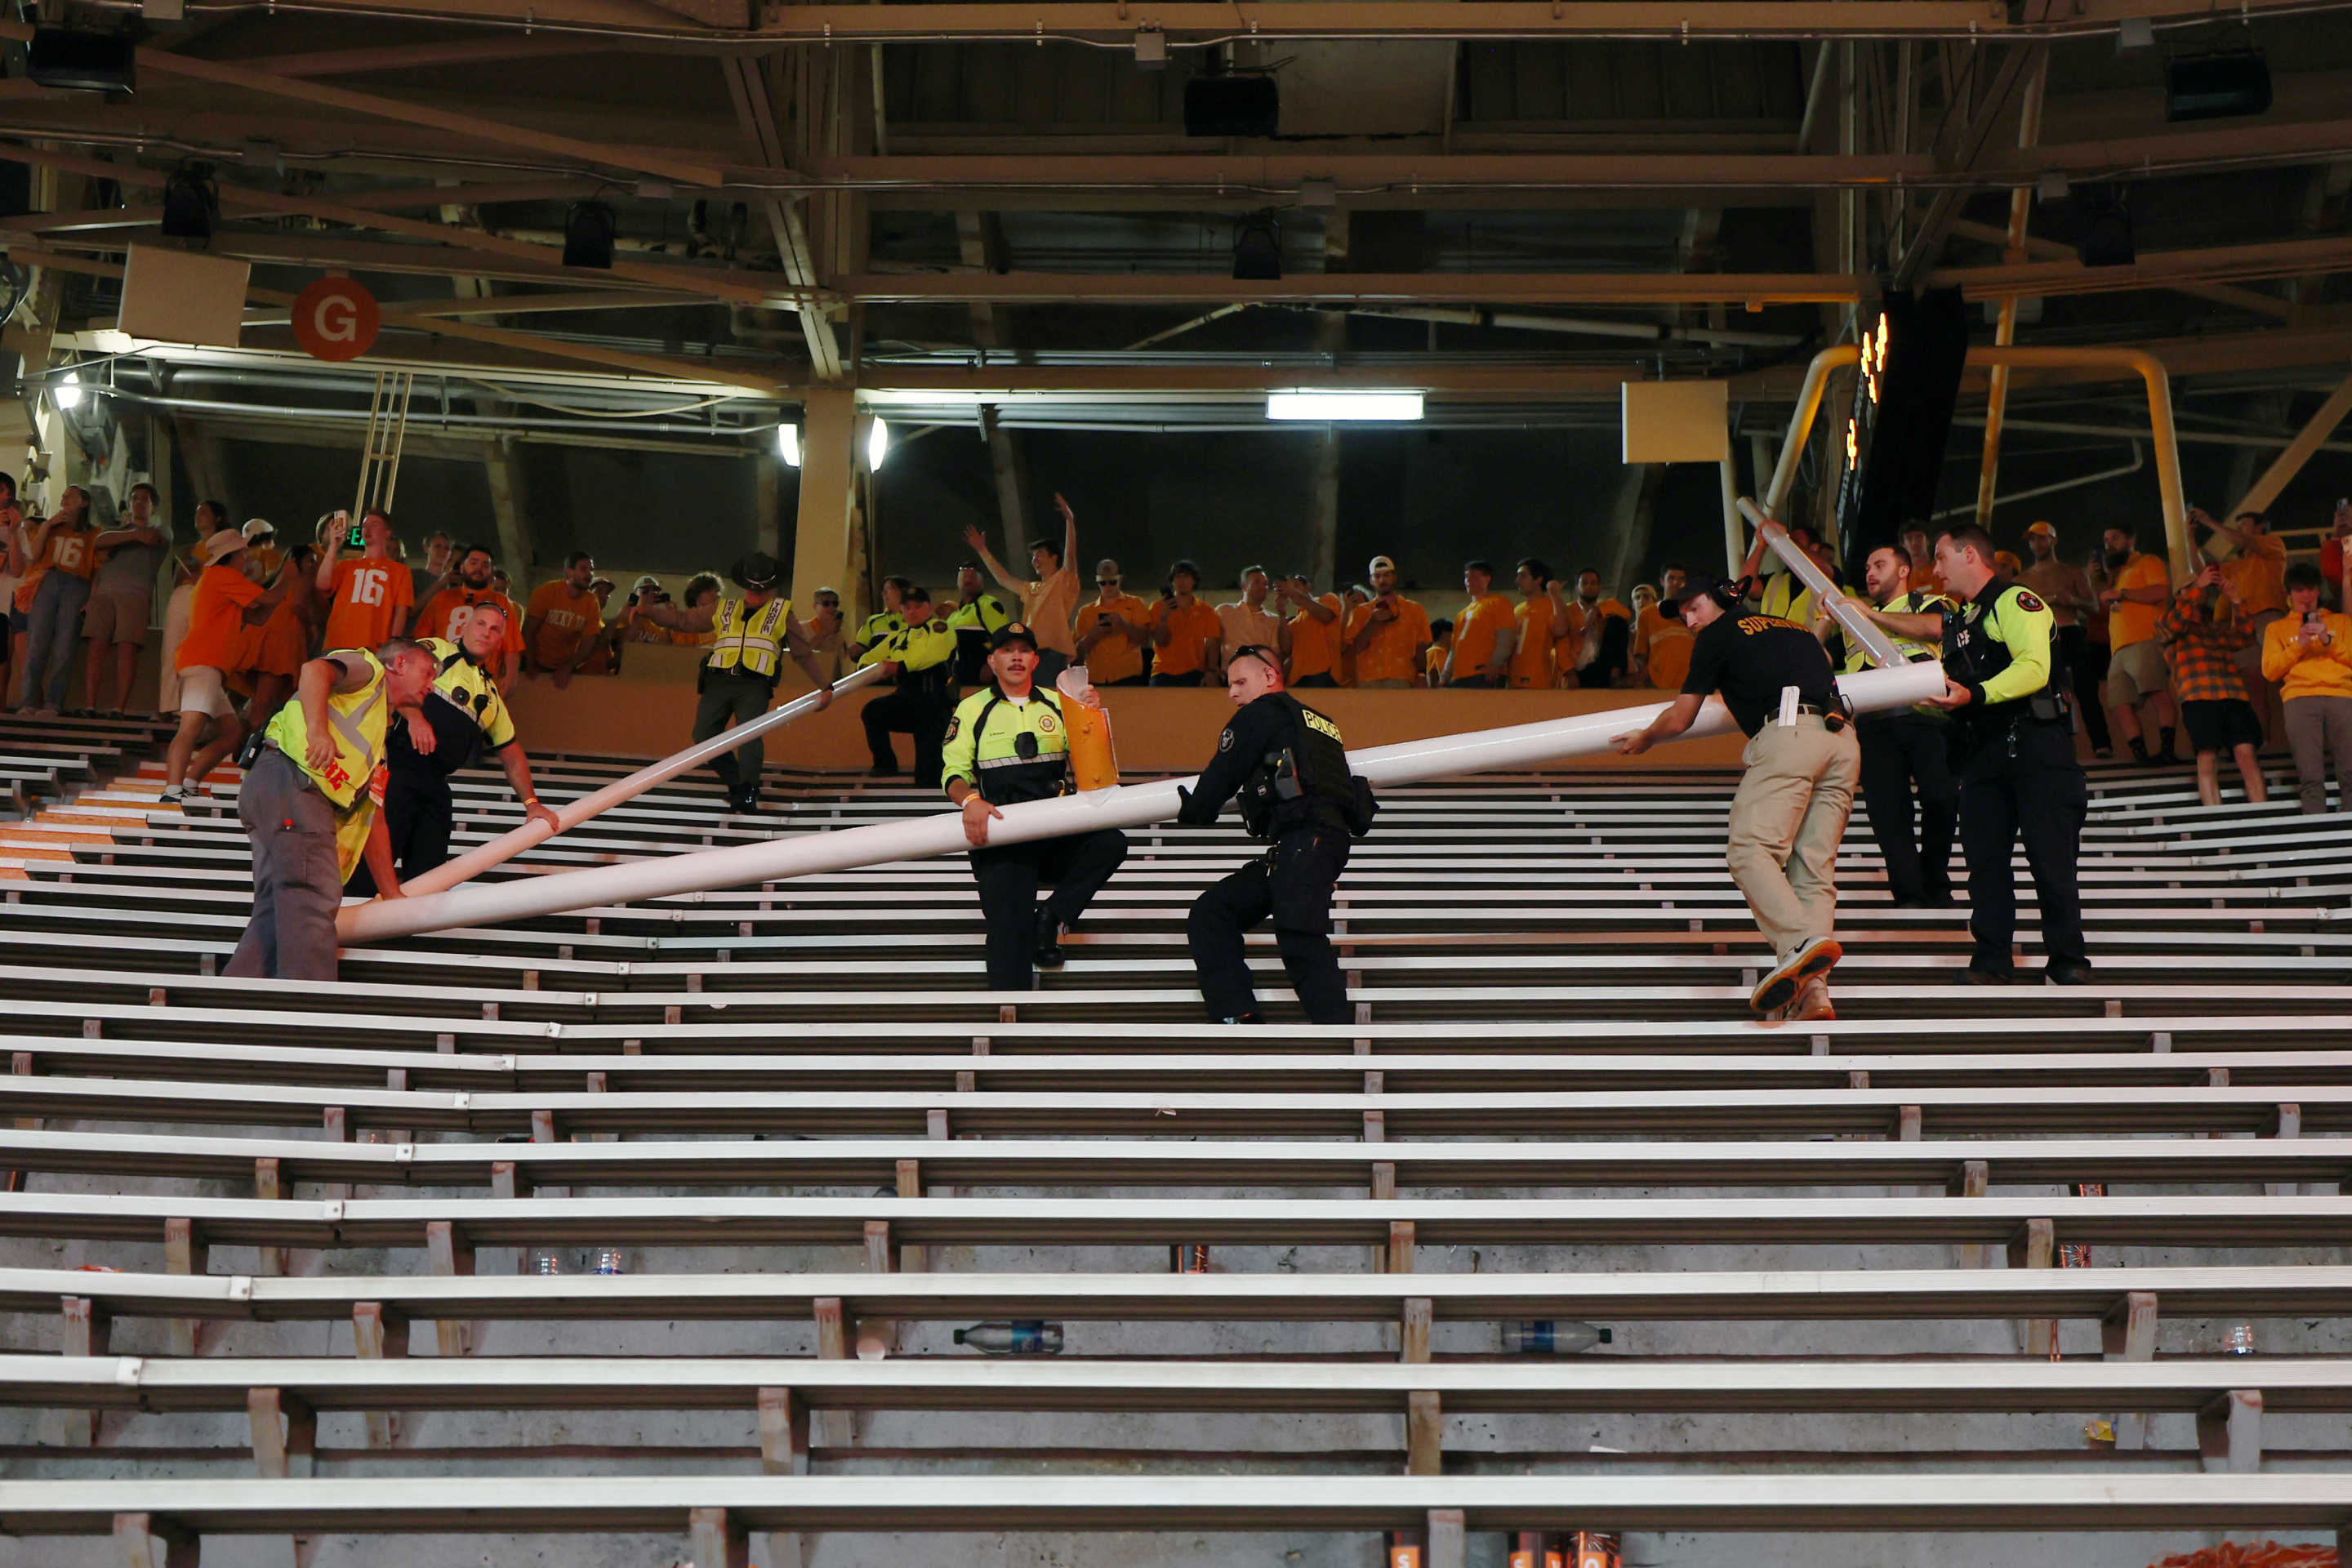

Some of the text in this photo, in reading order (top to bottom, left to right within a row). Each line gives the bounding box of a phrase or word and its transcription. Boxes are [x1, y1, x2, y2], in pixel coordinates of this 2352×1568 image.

[314, 294, 357, 342] G
[51, 536, 86, 568] 16
[350, 568, 389, 608] 16
[1304, 711, 1342, 742] POLICE
